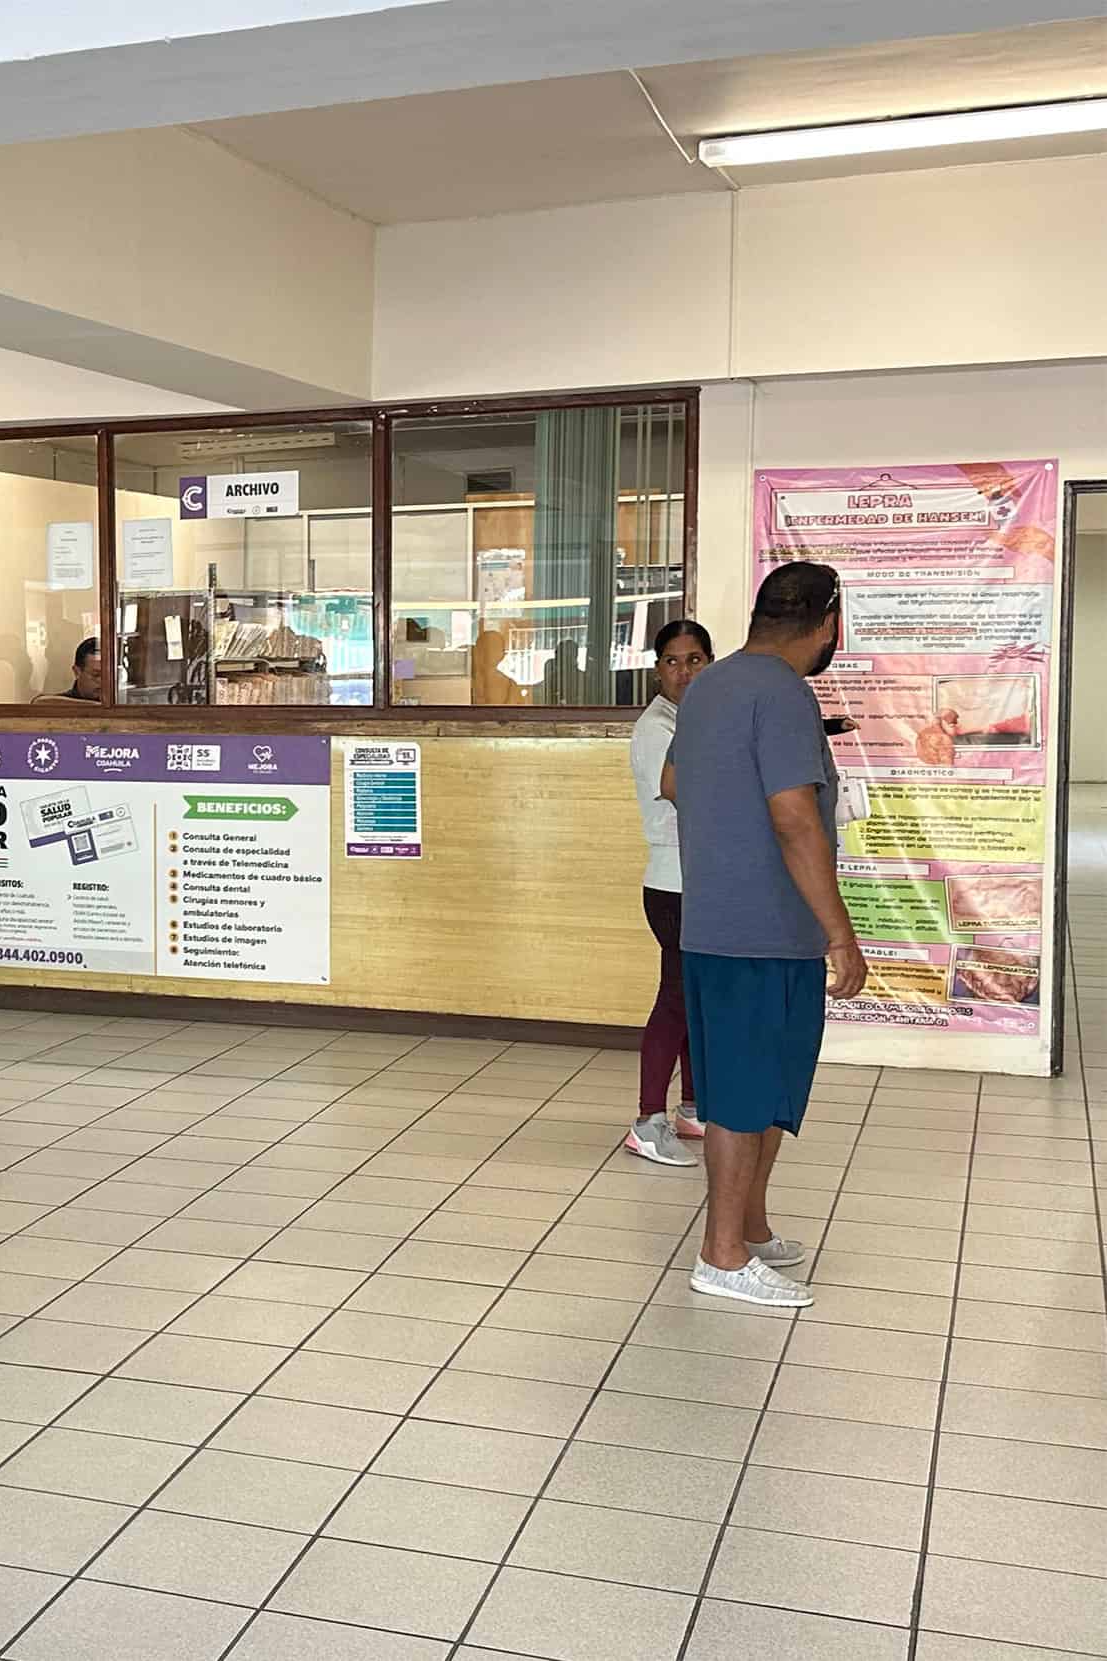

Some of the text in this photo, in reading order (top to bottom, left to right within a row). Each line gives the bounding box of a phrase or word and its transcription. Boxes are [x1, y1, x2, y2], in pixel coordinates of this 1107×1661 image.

[225, 482, 280, 497] ARCHIVO
[847, 494, 913, 509] LEPRA
[892, 513, 913, 524] DE
[85, 745, 140, 759] MEJORA
[196, 749, 210, 757] SS
[96, 759, 132, 767] COAHUILA
[40, 803, 71, 817] SALUD
[196, 801, 287, 815] BENEFICIOS:
[182, 832, 221, 841] Consulta
[223, 833, 257, 842] General
[182, 845, 291, 858] Consulta de especialidad
[189, 858, 216, 866] través
[219, 859, 230, 867] de
[232, 860, 289, 869] Telemedicina
[182, 870, 323, 883] Medicamentos de cuadro básico
[73, 882, 110, 892] REGISTRO:
[182, 883, 221, 892] Consulta
[223, 884, 251, 893] dental
[220, 898, 258, 906] menores
[260, 899, 266, 907] y
[182, 909, 239, 918] ambulatorias
[183, 921, 283, 933] Estudios de laboratorio
[183, 934, 220, 943] Estudios
[221, 935, 233, 943] de
[234, 935, 267, 946] imagen
[183, 946, 240, 957] Seguimiento:
[183, 959, 222, 969] Atención
[983, 964, 1038, 976] LEPROMATOSA
